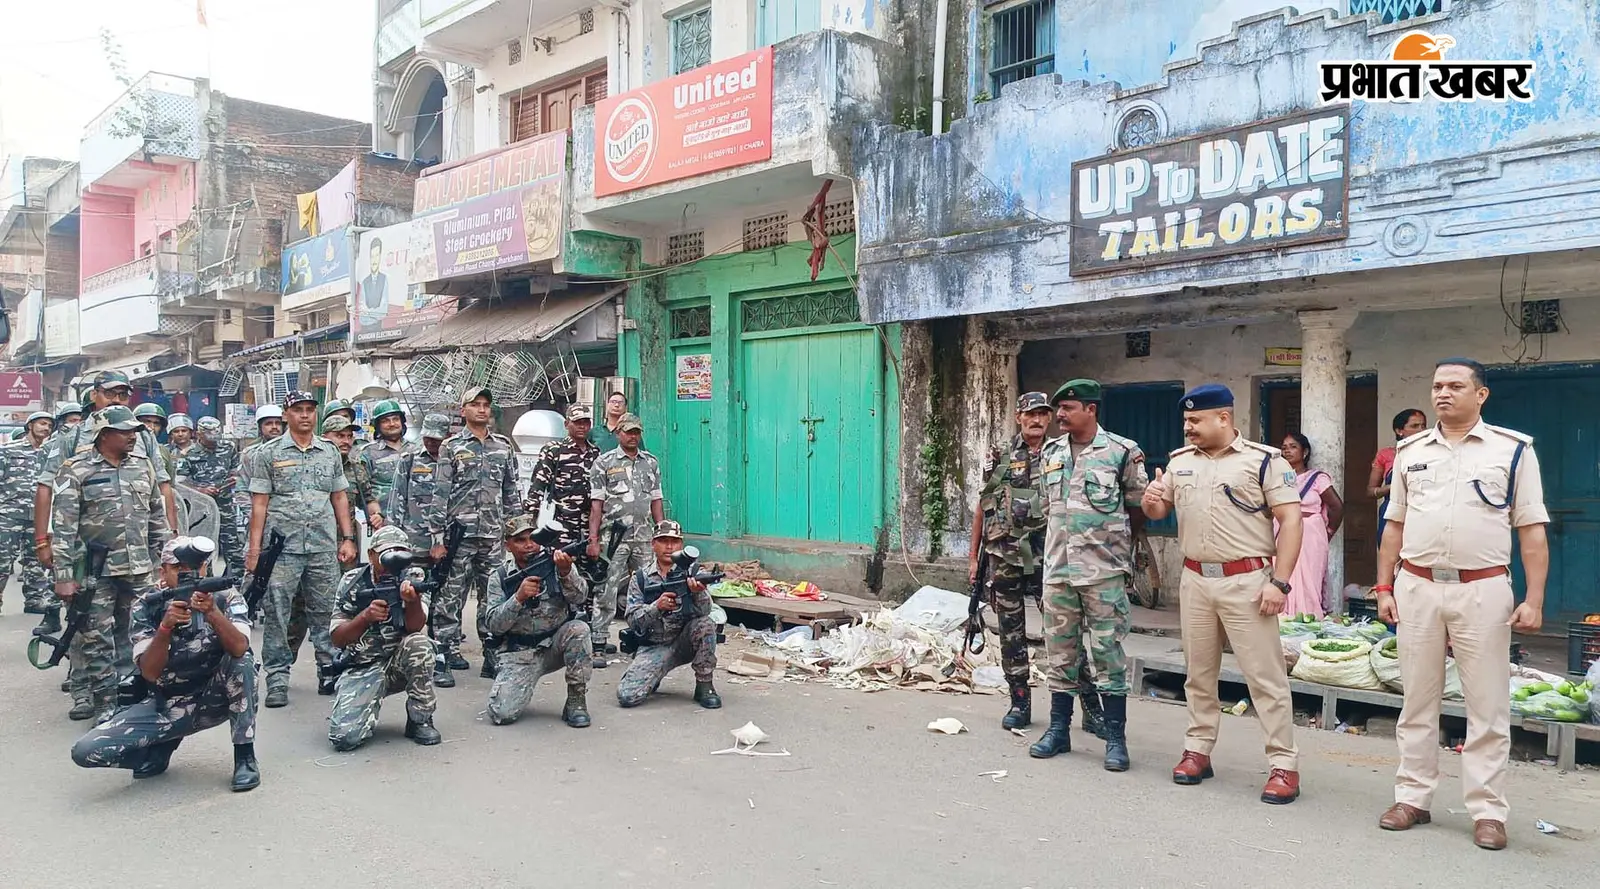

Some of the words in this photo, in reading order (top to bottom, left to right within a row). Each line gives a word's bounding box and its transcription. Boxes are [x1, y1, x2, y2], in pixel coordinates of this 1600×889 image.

[673, 61, 757, 109] United
[608, 123, 650, 160] UNITED
[743, 140, 765, 151] CHATRA
[415, 159, 492, 214] BALAJEE
[492, 138, 560, 191] METAL
[1078, 157, 1150, 219] UP
[1199, 115, 1344, 199] DATE
[445, 236, 467, 253] Steel
[469, 226, 513, 249] Crockery
[1098, 188, 1324, 261] TAILORS
[358, 332, 376, 341] CHANDAN
[376, 329, 402, 339] ELECTRONICS
